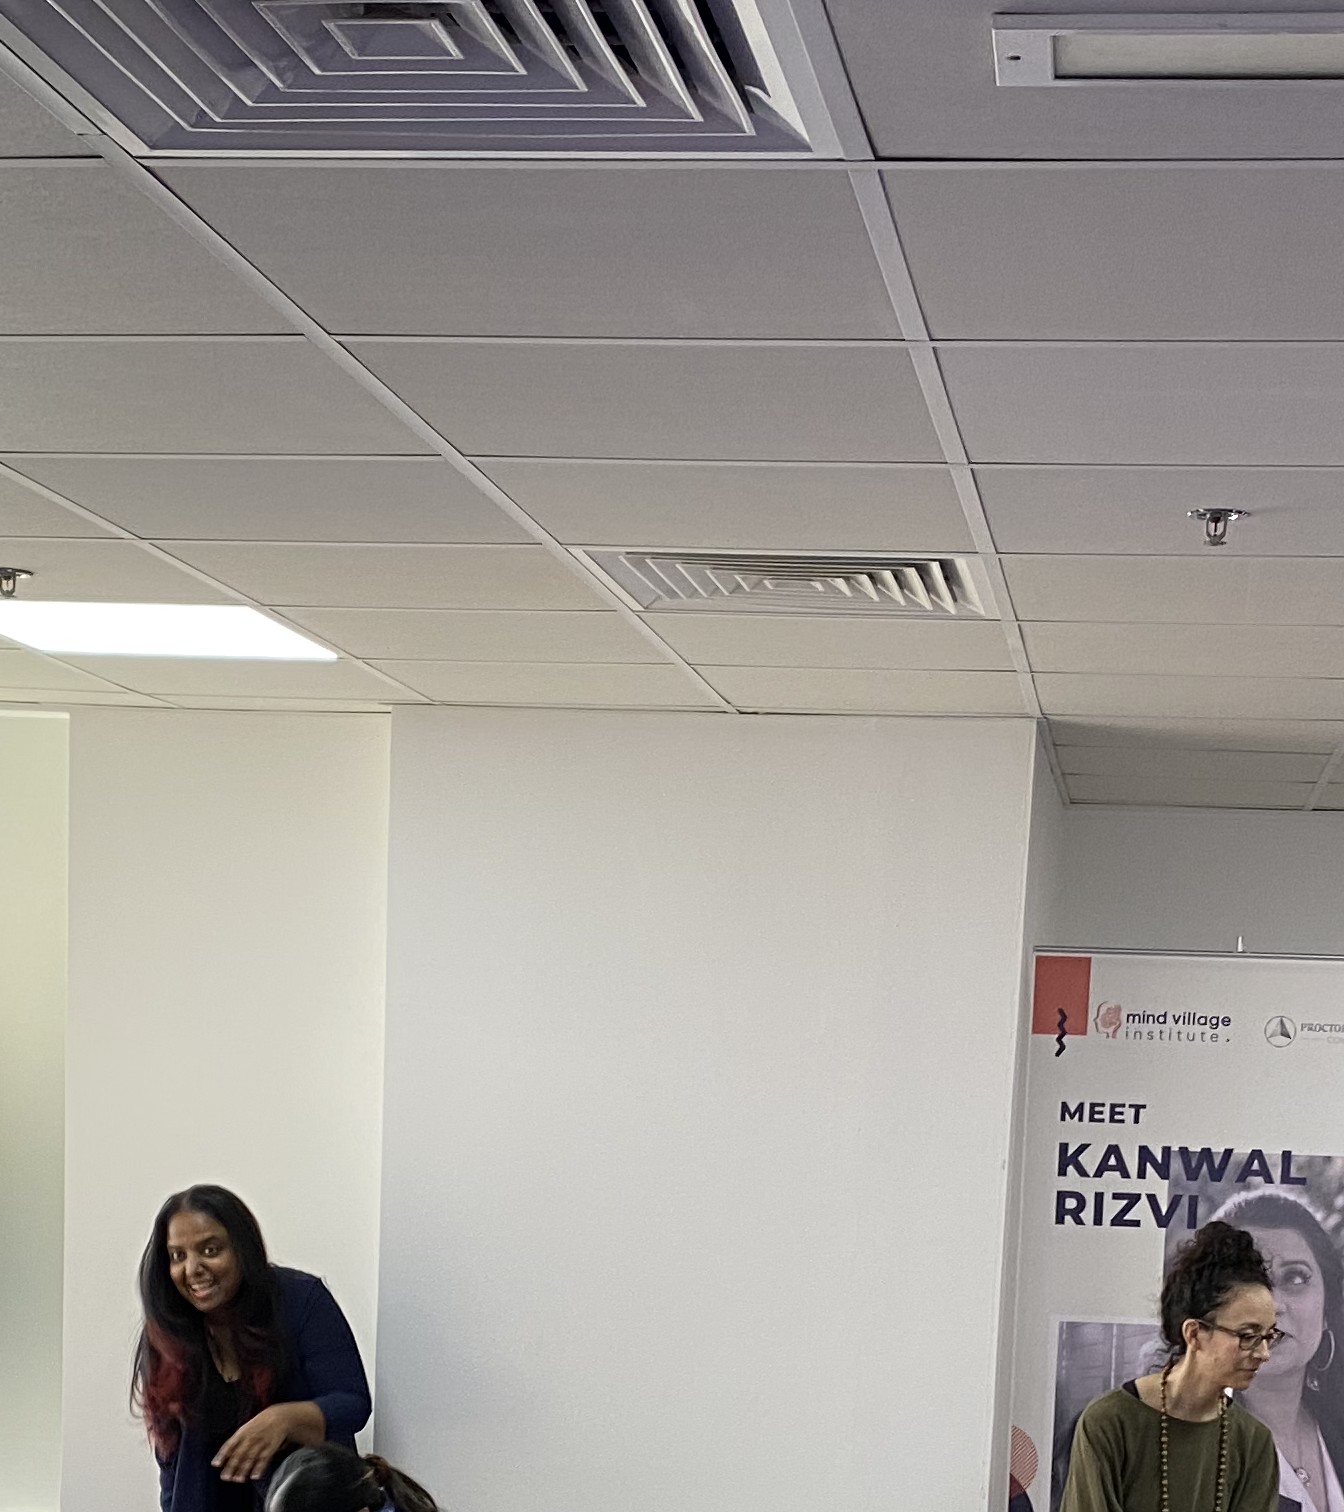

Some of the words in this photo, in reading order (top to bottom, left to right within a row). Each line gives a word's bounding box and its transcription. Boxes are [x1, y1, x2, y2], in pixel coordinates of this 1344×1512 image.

[1126, 1010, 1167, 1025] mind
[1172, 1011, 1231, 1029] village
[1060, 1101, 1147, 1124] MEET
[1057, 1142, 1307, 1185] KANWAL
[1055, 1190, 1199, 1229] RIZVI
